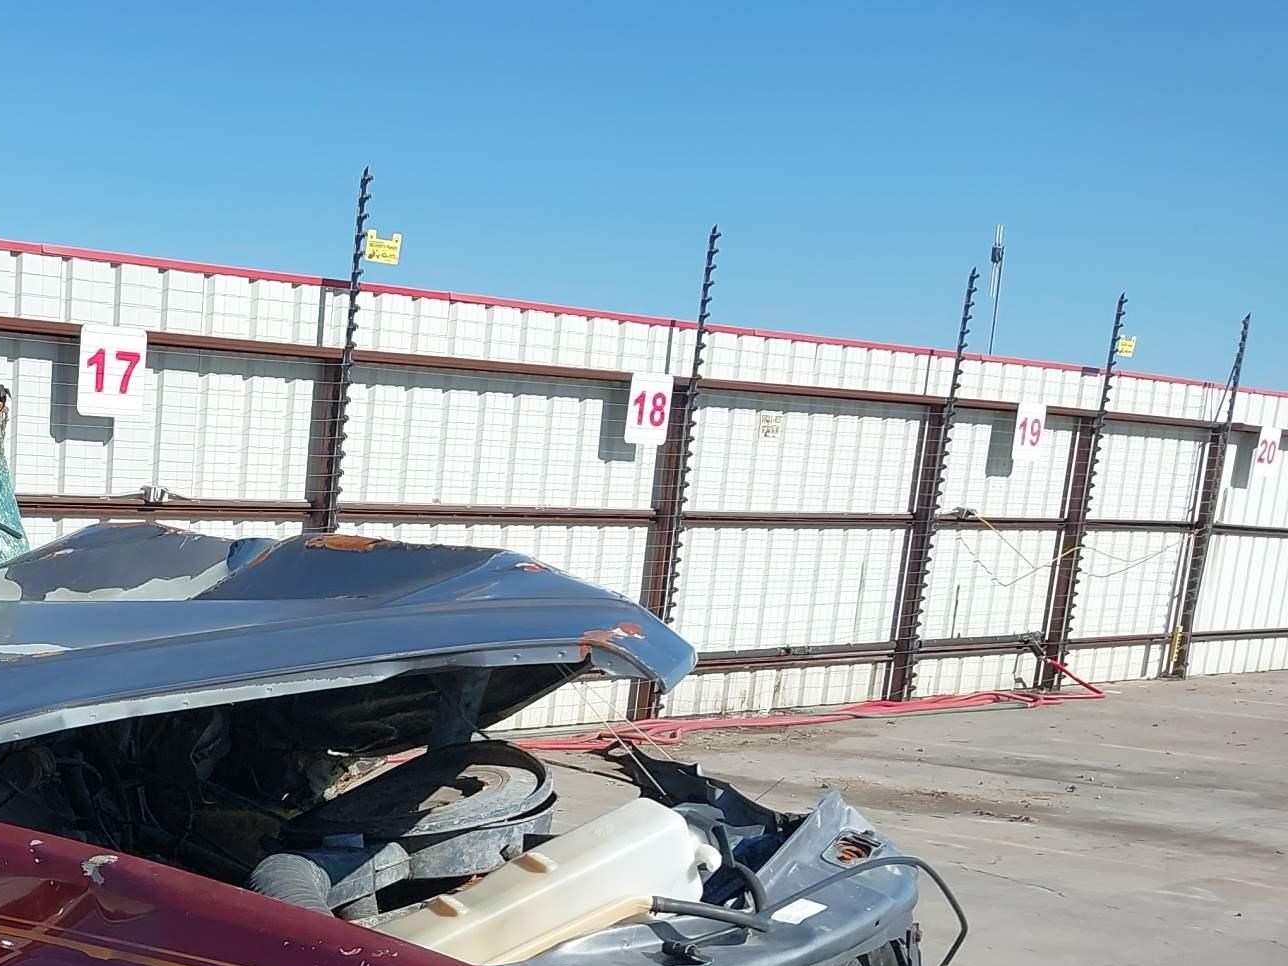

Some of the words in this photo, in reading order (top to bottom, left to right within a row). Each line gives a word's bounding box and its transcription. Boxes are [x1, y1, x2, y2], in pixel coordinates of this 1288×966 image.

[87, 348, 141, 395] 17
[633, 390, 667, 427] 18
[1018, 417, 1042, 447] 19
[1257, 439, 1277, 465] 20
